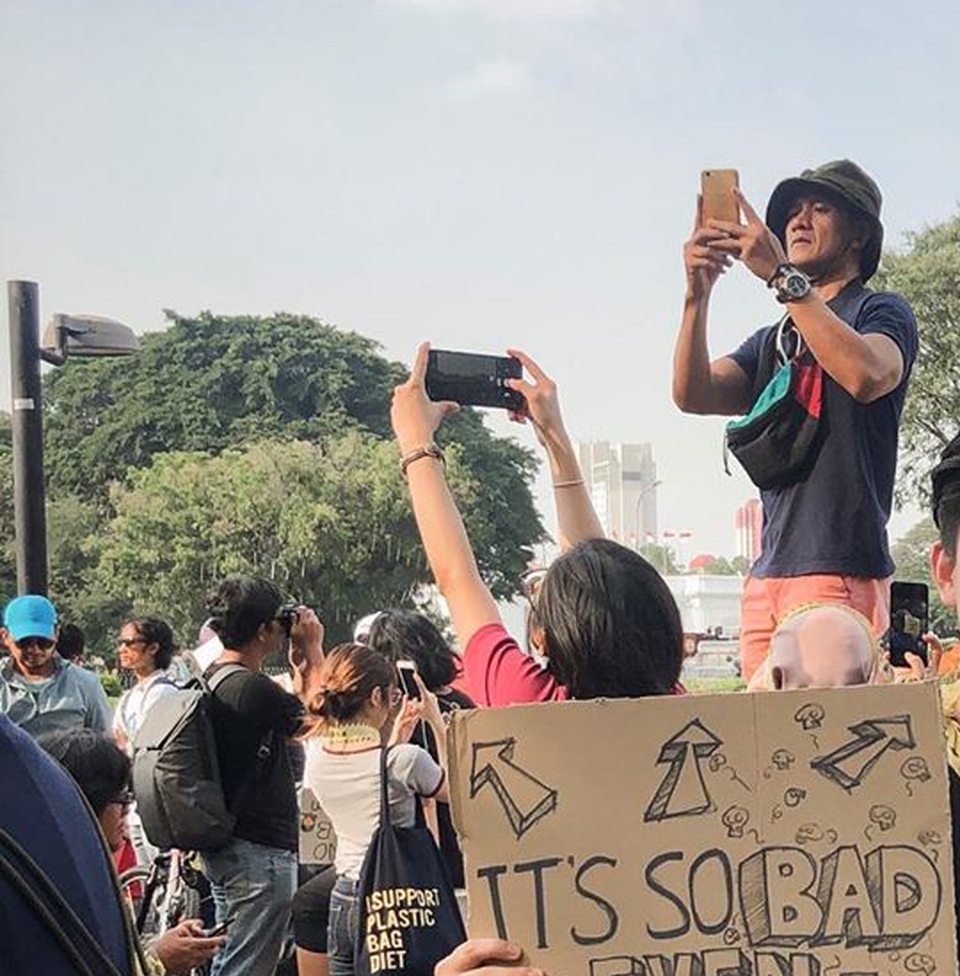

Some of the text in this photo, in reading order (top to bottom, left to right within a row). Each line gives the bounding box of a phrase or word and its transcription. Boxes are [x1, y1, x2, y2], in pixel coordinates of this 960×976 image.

[371, 888, 440, 911] SUPPORT
[477, 844, 943, 953] IT'S SO BAD
[366, 909, 436, 934] PLASTIC
[367, 930, 403, 953] BAG
[369, 950, 407, 975] DIET
